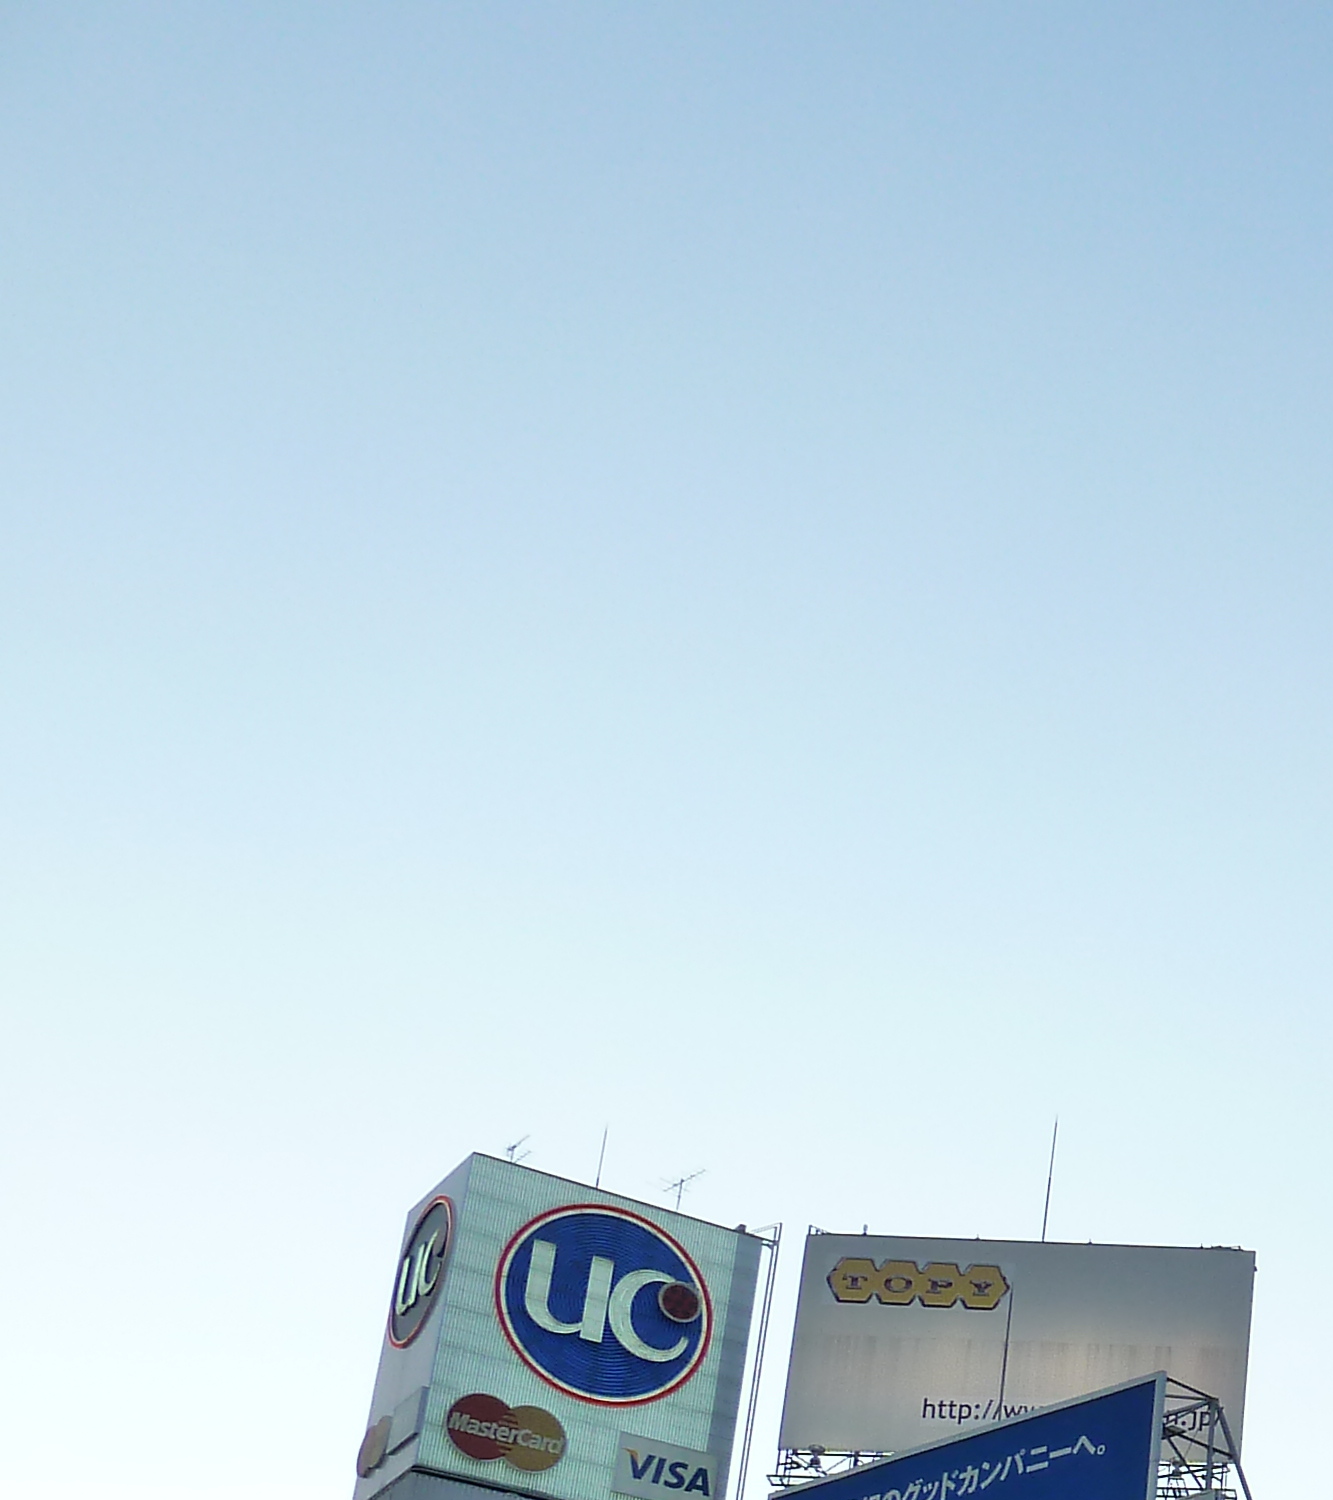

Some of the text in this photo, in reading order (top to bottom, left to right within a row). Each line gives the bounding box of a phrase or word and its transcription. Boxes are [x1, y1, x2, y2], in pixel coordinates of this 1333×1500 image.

[841, 1271, 995, 1298] TOPY
[449, 1408, 566, 1458] MasterCard
[626, 1446, 712, 1498] VISA
